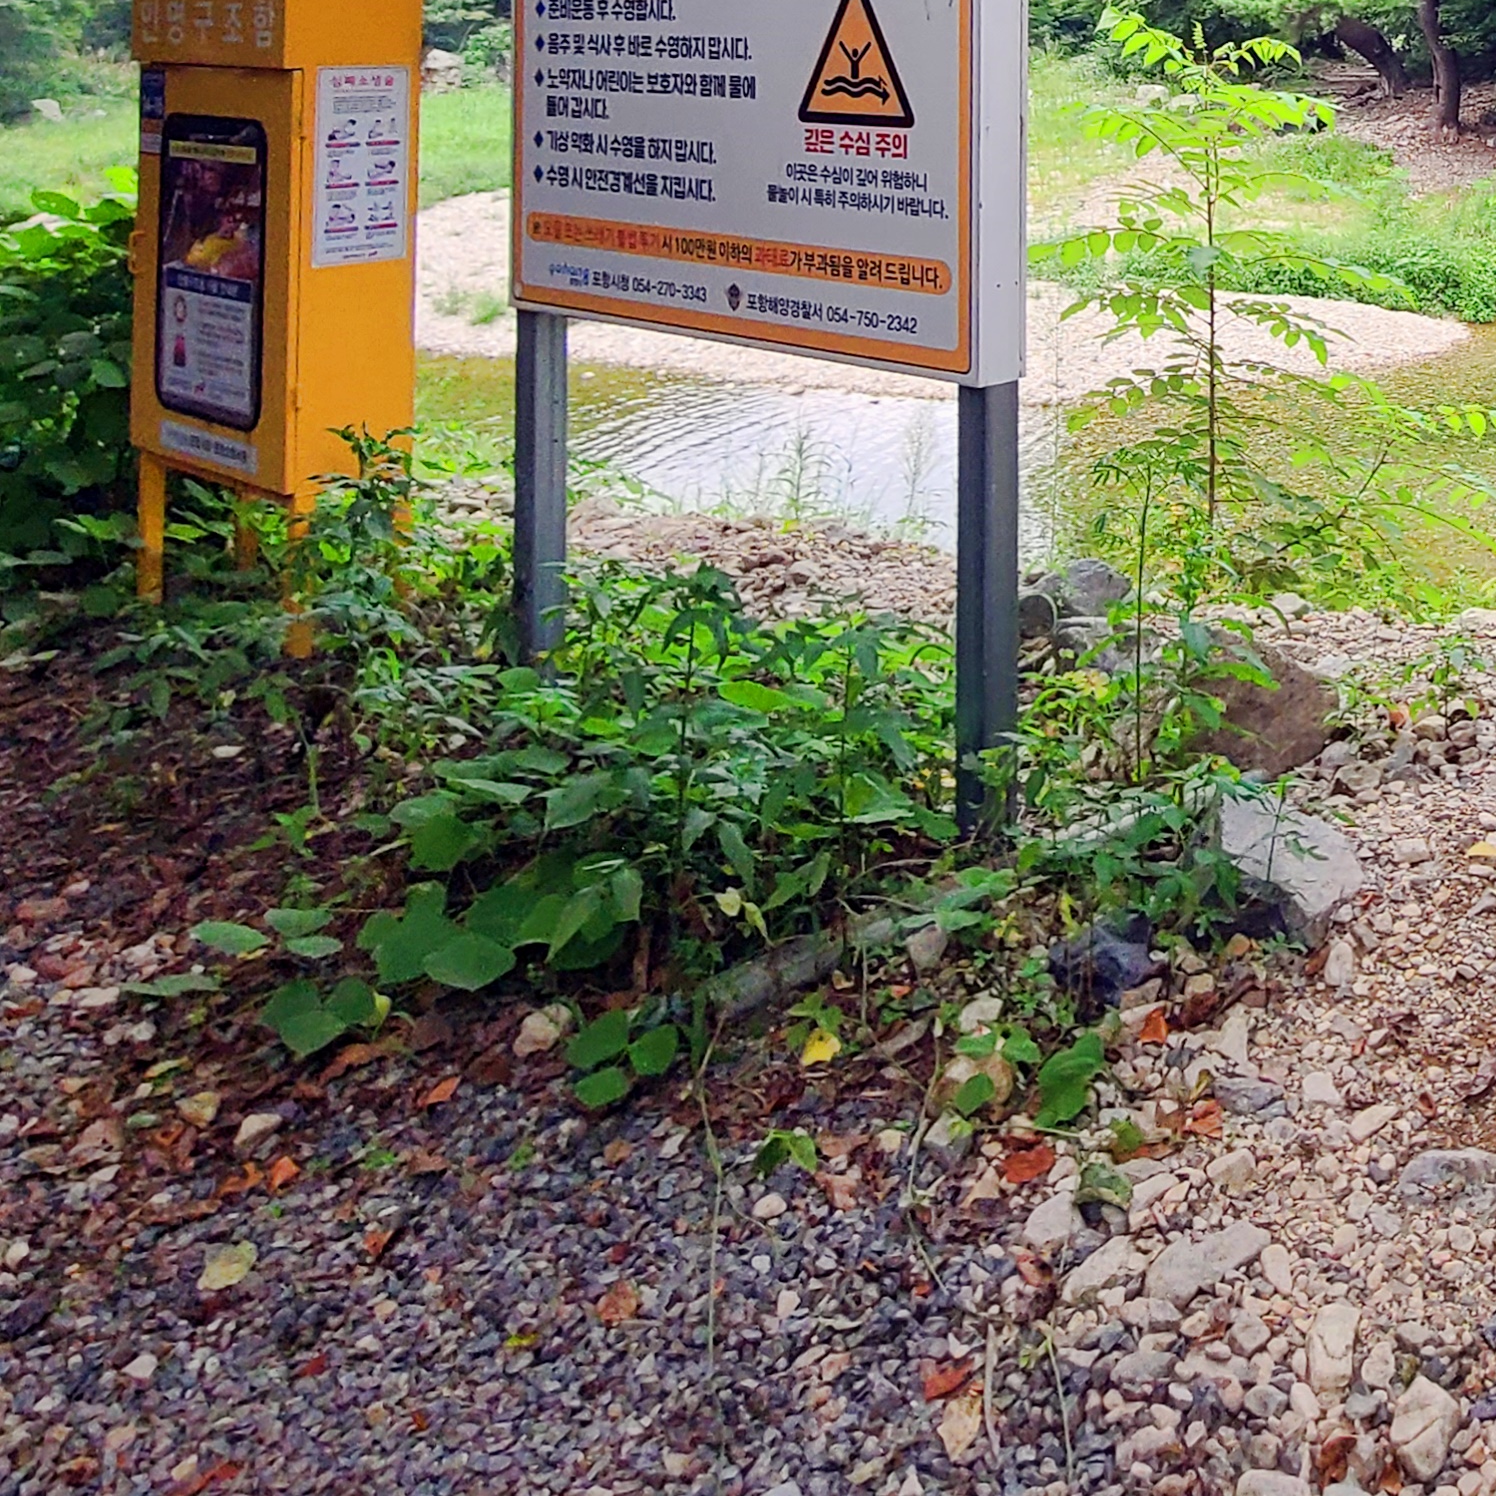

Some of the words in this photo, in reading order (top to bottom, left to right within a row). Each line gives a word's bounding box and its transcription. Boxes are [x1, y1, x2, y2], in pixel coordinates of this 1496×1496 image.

[548, 0, 594, 21] 준비운동
[597, 0, 608, 21] 후
[611, 0, 676, 21] 수영합시다.
[547, 33, 570, 55] 음주
[573, 34, 585, 55] 및
[588, 34, 611, 56] 식사
[613, 35, 626, 57] 후
[628, 36, 652, 57] 바로
[655, 37, 705, 59] 수영하지
[709, 37, 752, 60] 맙시다.
[547, 68, 594, 91] 노약자나
[596, 71, 644, 93] 어린이는
[646, 73, 696, 96] 보호자와
[700, 75, 725, 97] 함께
[729, 76, 756, 99] 물에
[546, 96, 568, 117] 들어
[571, 97, 609, 118] 갑시다.
[547, 131, 568, 152] 기상
[571, 133, 594, 154] 악화
[597, 134, 607, 154] 시
[610, 135, 644, 158] 수영을
[648, 138, 672, 160] 하지
[675, 140, 717, 164] 맙시다.
[804, 128, 834, 153] 깊은
[839, 131, 870, 156] 수심
[875, 133, 908, 159] 주의
[547, 165, 569, 187] 수영
[572, 167, 583, 188] 시
[585, 168, 659, 196] 안전경계선을
[661, 175, 716, 201] 지킵시다.
[786, 163, 818, 182] 이곳은
[820, 166, 853, 186] 수심이
[856, 169, 878, 189] 깊어
[881, 170, 927, 192] 위험하니
[767, 184, 798, 205] 물놀이
[801, 188, 812, 206] 시
[814, 189, 835, 208] 특히
[838, 192, 895, 214] 주의하시기
[897, 198, 948, 219] 바랍니다.
[662, 235, 672, 253] 시
[675, 237, 717, 260] 100만원
[719, 241, 752, 264] 이하의
[804, 251, 854, 278] 부과됨을
[857, 259, 881, 282] 알려
[884, 262, 943, 290] 드립니다.
[592, 271, 630, 292] 포항시청
[632, 277, 707, 303] 054-270-3343
[746, 294, 823, 321] 포항해양경찰서
[827, 305, 918, 334] 054-750-2342
